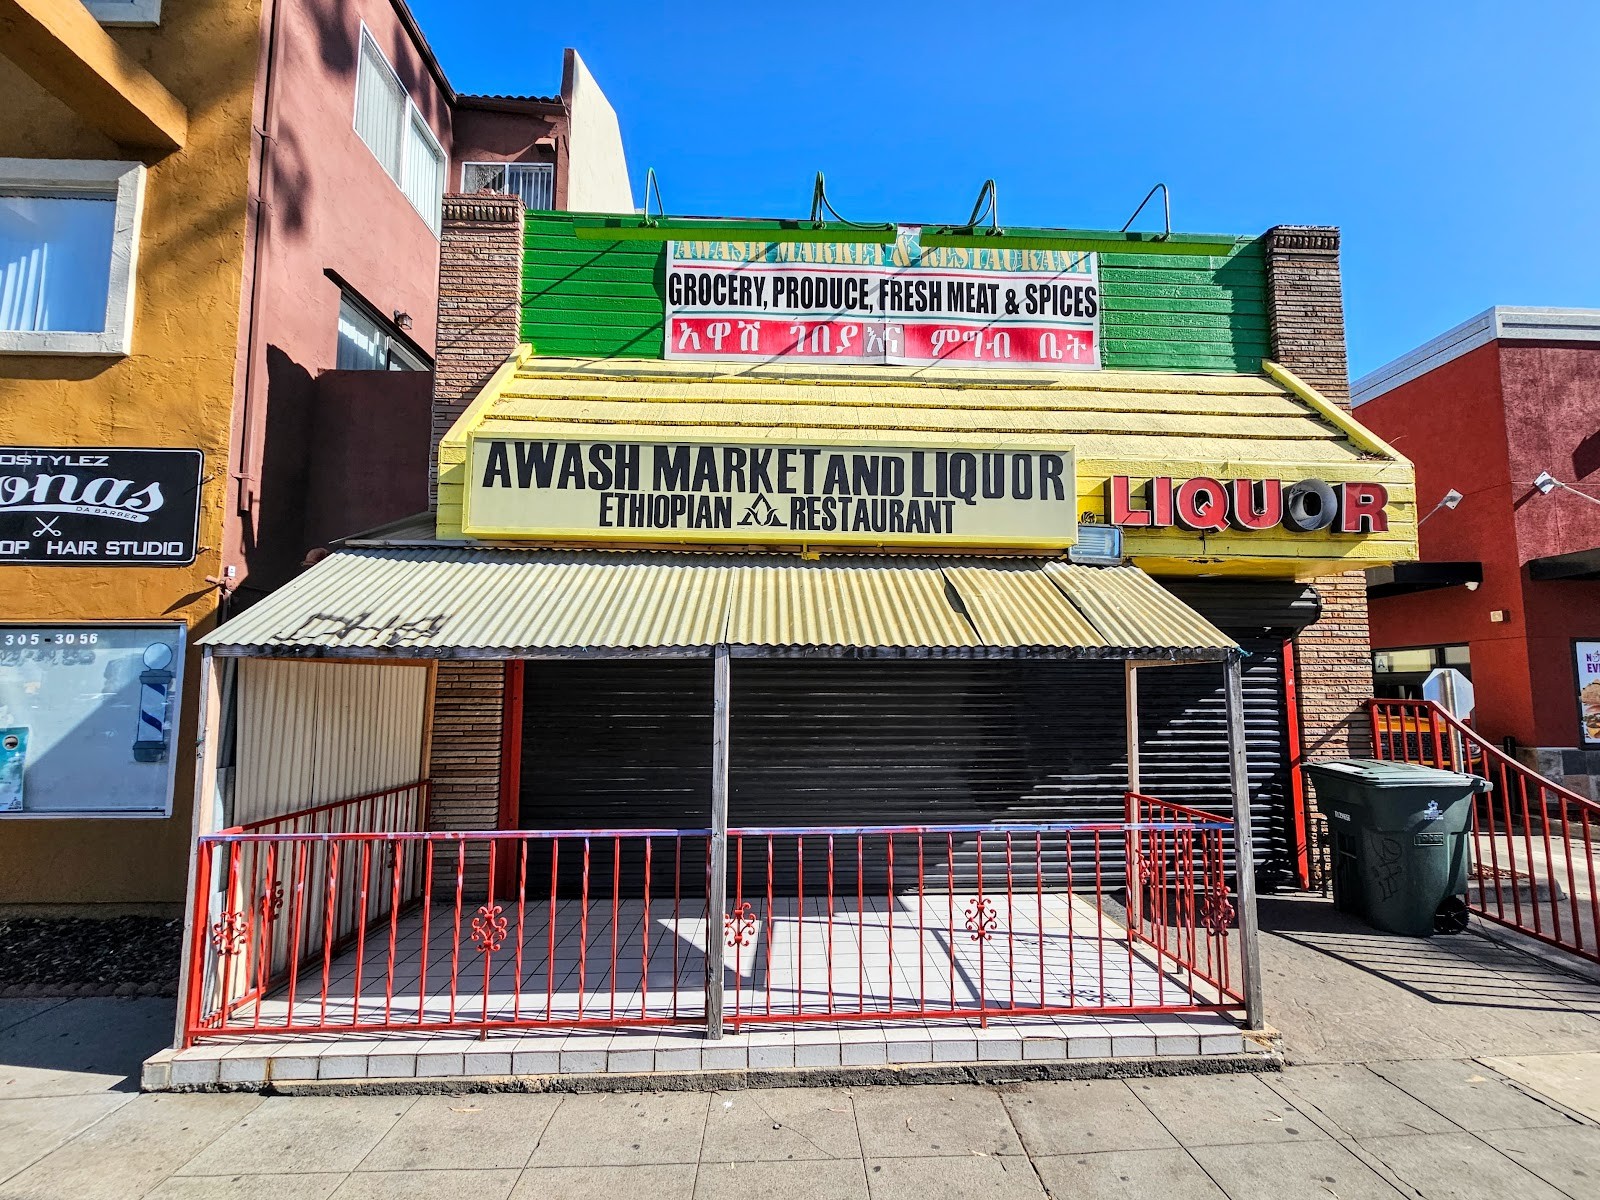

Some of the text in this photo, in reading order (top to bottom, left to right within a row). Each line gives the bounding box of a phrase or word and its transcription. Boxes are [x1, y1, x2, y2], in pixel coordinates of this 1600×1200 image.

[892, 234, 912, 267] &
[668, 272, 1097, 318] GROCERY, PRODUCE, FRESH MEAT & SPICES
[482, 441, 1065, 505] AWASH MARKET AND LIQUOR
[94, 508, 138, 520] BARBER
[599, 492, 956, 534] ETHIOPIAN RESTAURANT
[1108, 475, 1389, 533] LIQUOR
[47, 541, 98, 555] HAIR
[105, 541, 184, 556] STUDIO
